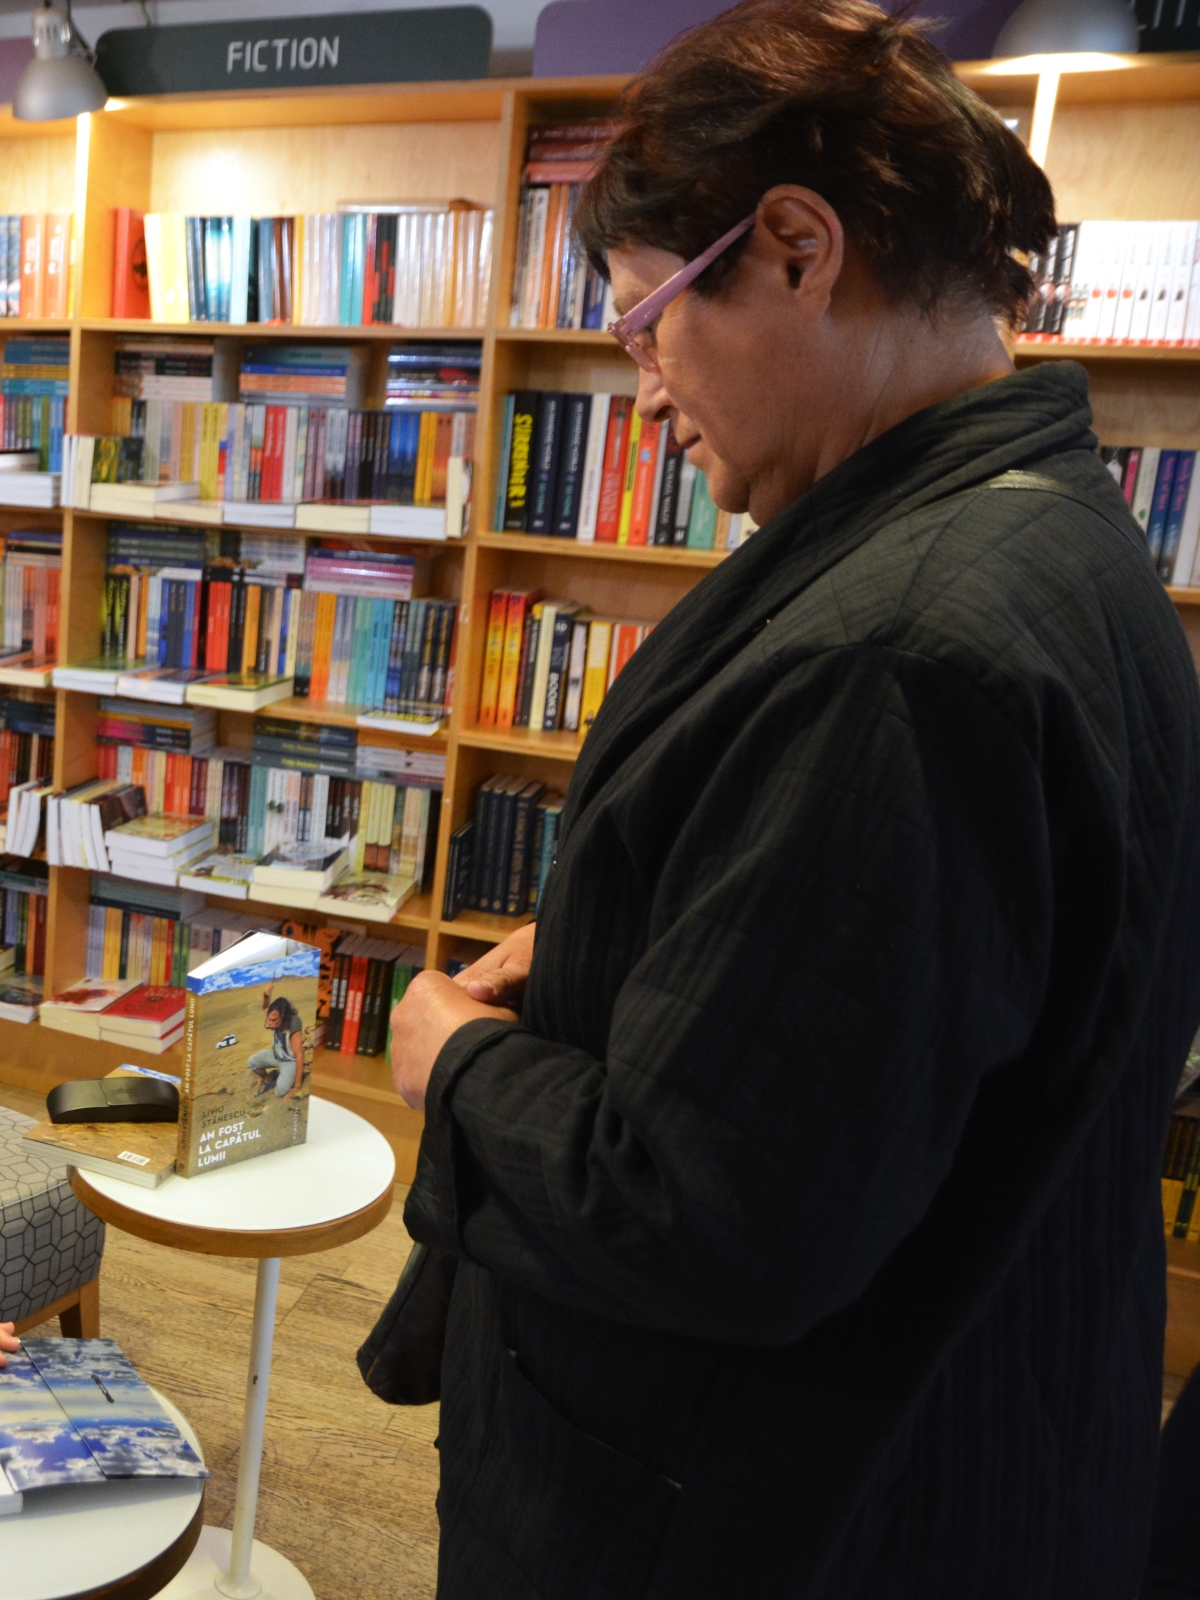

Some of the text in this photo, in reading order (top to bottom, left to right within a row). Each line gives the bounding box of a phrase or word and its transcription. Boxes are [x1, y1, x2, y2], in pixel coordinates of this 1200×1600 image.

[227, 35, 340, 73] FICTION
[508, 413, 533, 499] SURRENDER
[546, 672, 558, 717] BOOKS
[186, 1053, 192, 1062] LA
[185, 1082, 190, 1094] AM
[203, 1105, 224, 1118] LIVIU
[198, 1129, 261, 1155] LA CAPĂTUL
[200, 1121, 245, 1143] AM FOST
[198, 1151, 226, 1167] LUMII
